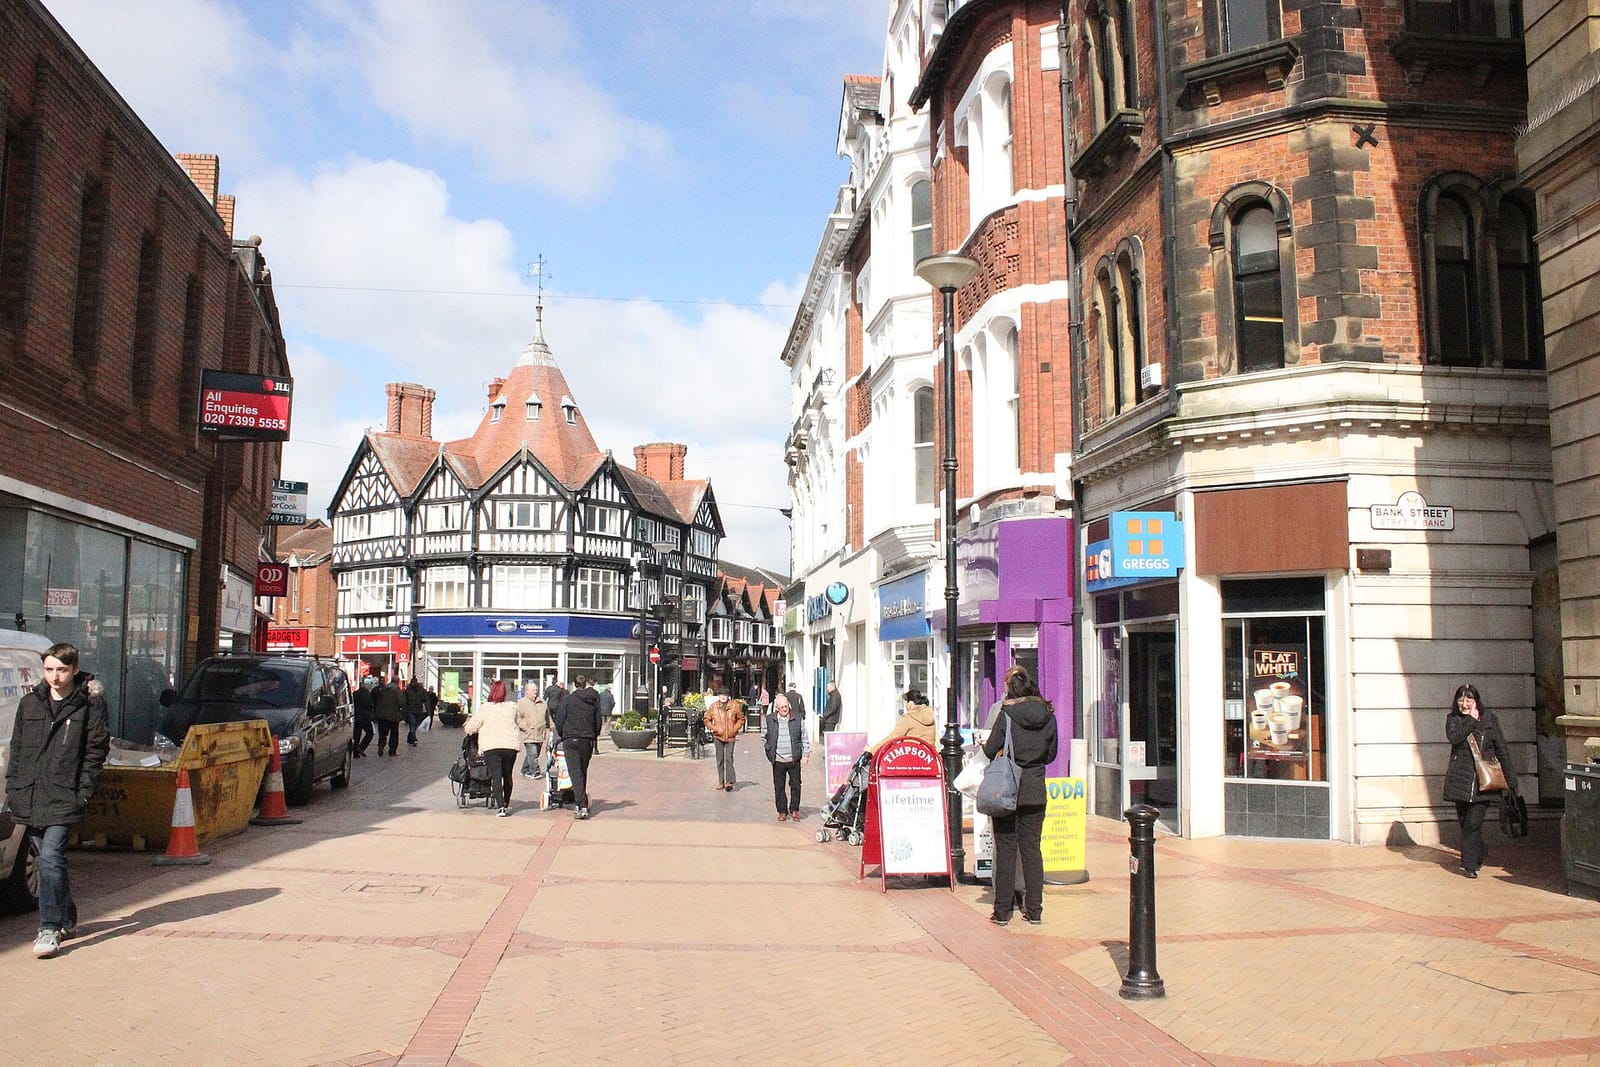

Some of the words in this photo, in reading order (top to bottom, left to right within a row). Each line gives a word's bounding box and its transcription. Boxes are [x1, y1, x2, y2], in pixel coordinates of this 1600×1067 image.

[274, 382, 290, 392] JLL
[206, 392, 221, 402] All
[206, 402, 258, 415] Enquiries
[204, 413, 225, 424] 020
[228, 415, 256, 427] 7399
[258, 417, 286, 430] 5555
[278, 482, 296, 490] LET
[1375, 508, 1404, 517] BANK
[1409, 508, 1449, 518] STREET
[1122, 558, 1170, 570] GREGGS
[259, 568, 283, 584] QD
[267, 631, 301, 641] GADGETS
[1261, 652, 1292, 663] FLAT
[1256, 663, 1296, 675] WHITE
[883, 746, 933, 764] TIMPSON
[1048, 780, 1084, 800] ODA
[1581, 781, 1591, 791] 64
[885, 794, 934, 805] Lifetime
